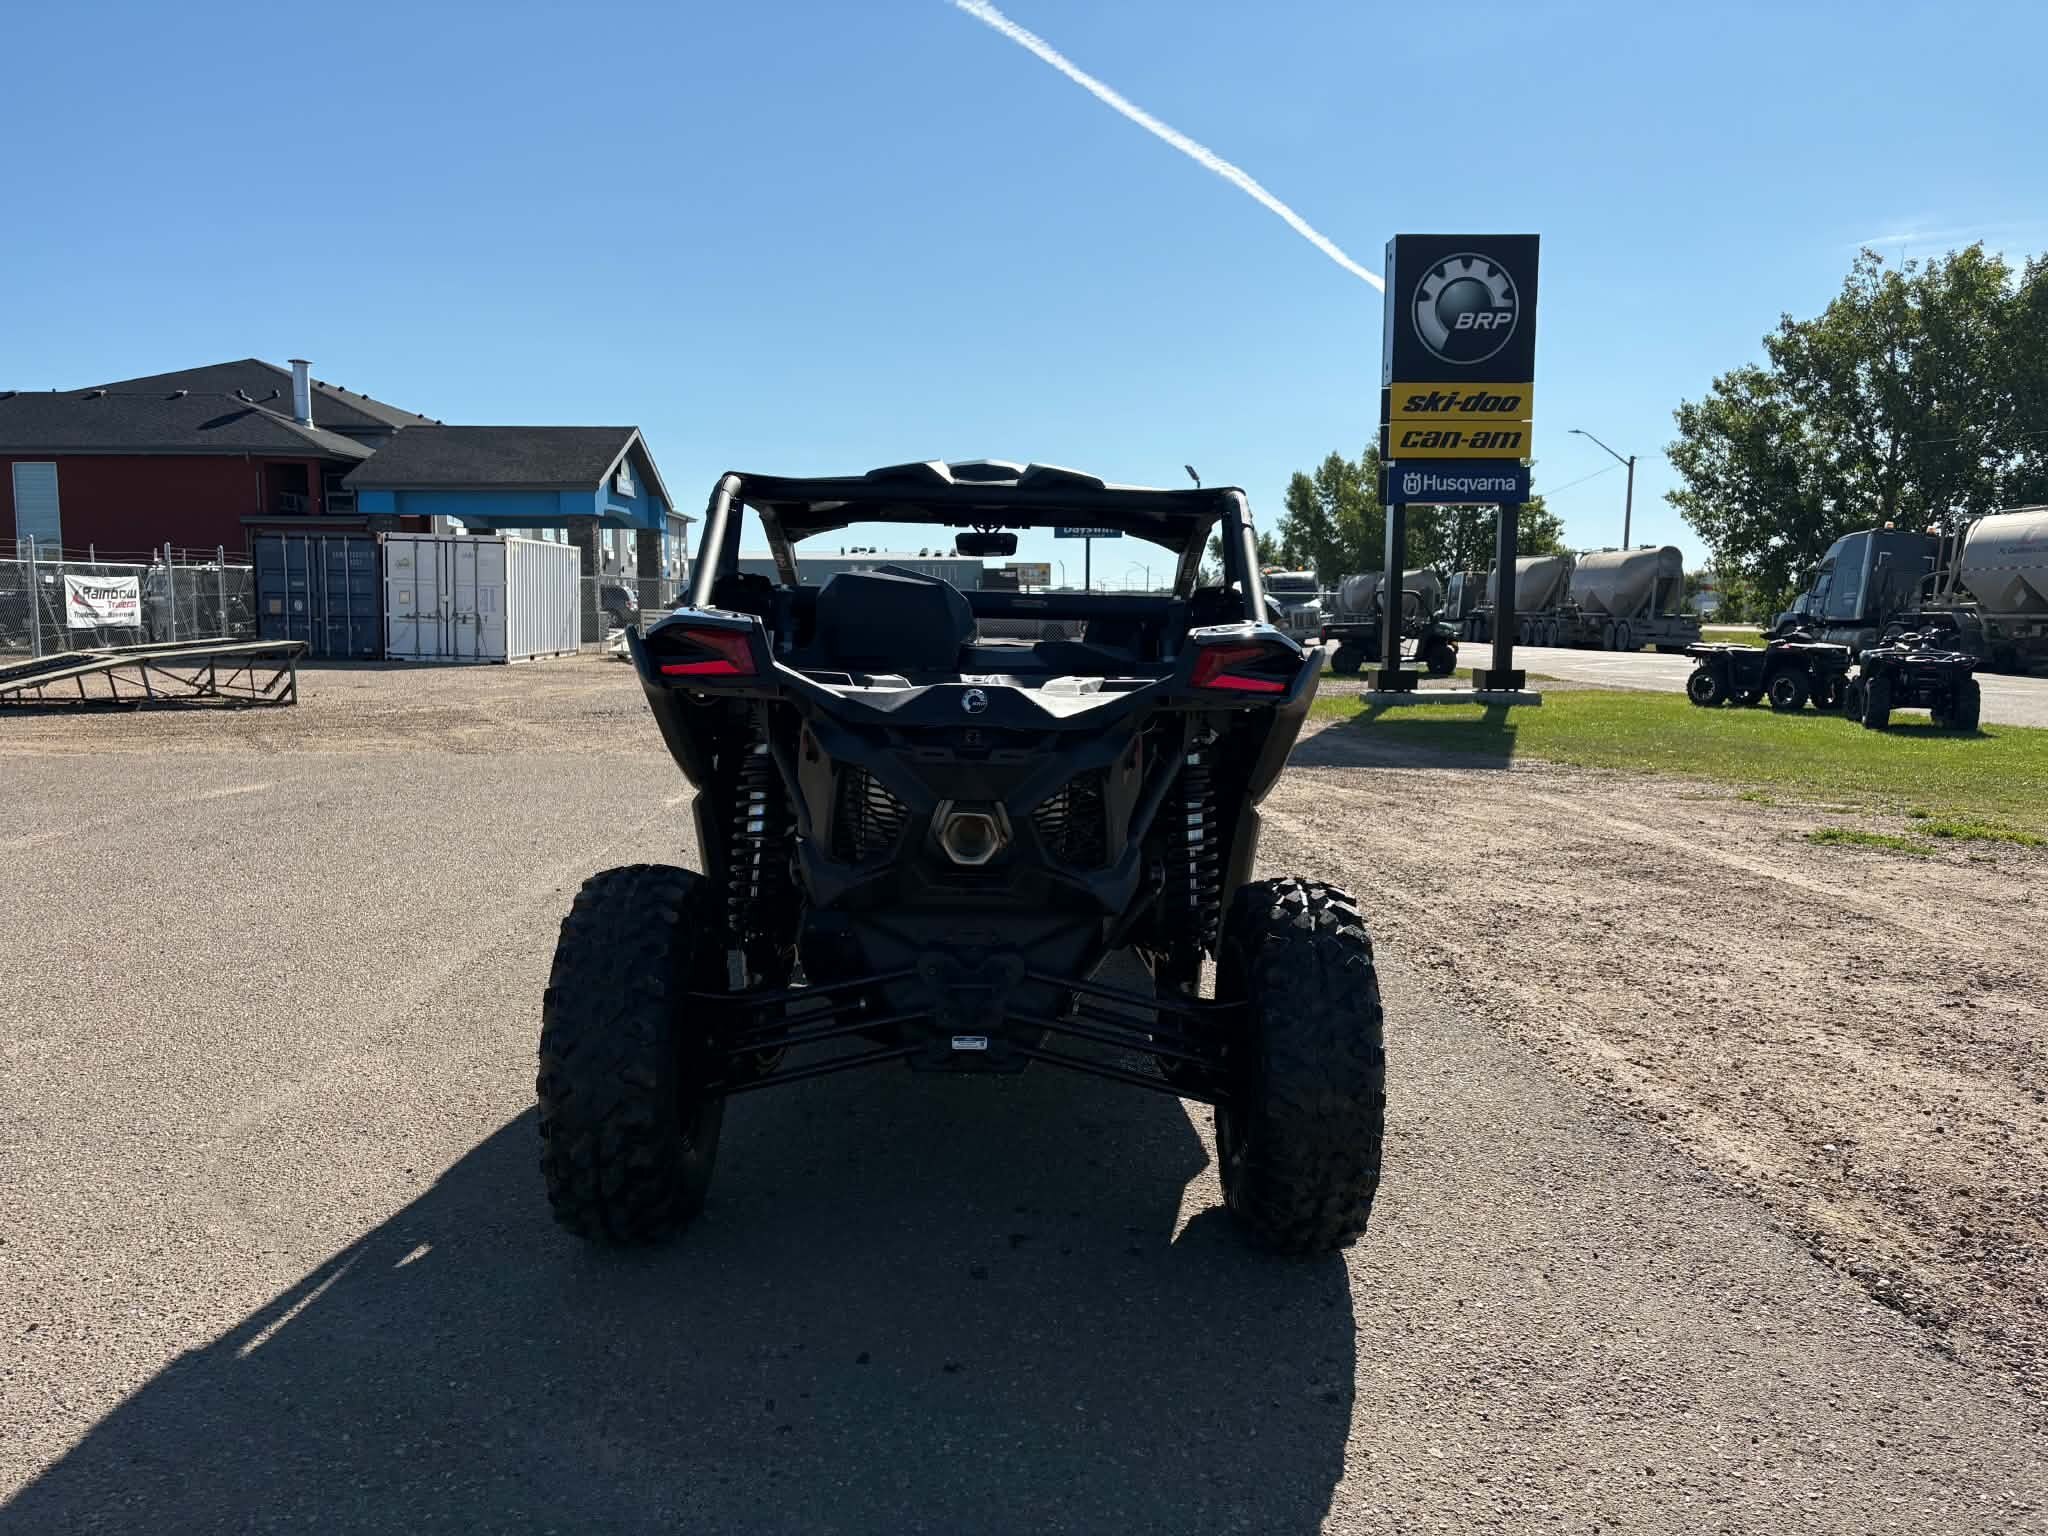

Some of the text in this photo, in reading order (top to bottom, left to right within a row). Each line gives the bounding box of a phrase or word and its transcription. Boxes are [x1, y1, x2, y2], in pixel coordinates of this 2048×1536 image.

[1455, 312, 1512, 330] BRP
[1402, 391, 1521, 412] ski-doo
[1400, 431, 1522, 449] can-am
[1424, 474, 1516, 494] Husqvarna
[83, 586, 137, 599] Rainbow
